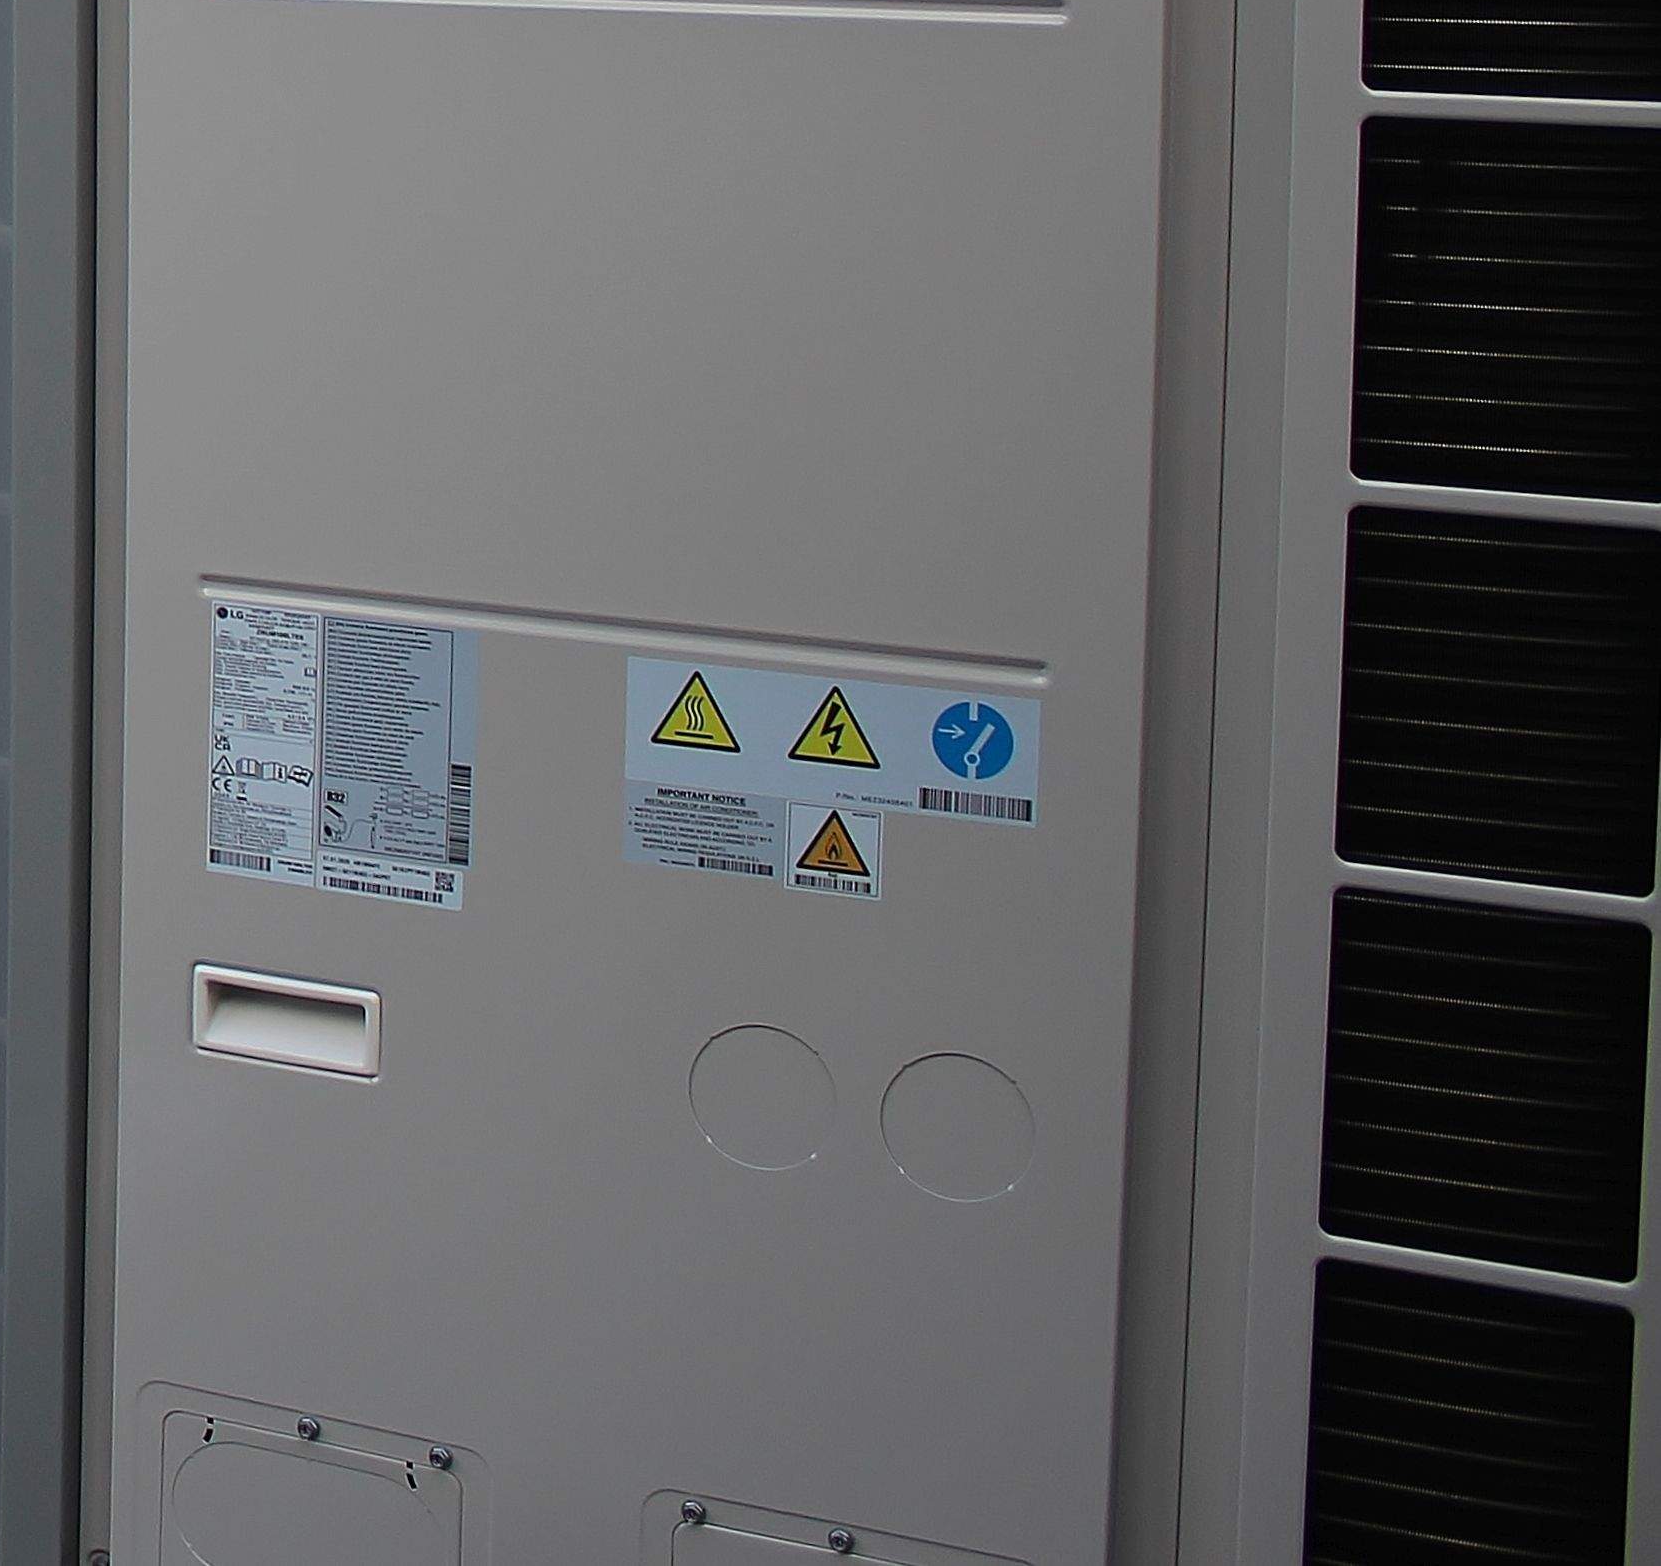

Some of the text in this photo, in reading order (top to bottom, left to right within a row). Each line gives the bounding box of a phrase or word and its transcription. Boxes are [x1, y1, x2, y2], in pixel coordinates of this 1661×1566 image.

[231, 610, 243, 619] LG
[657, 788, 746, 806] IMPORTANT NOTICE
